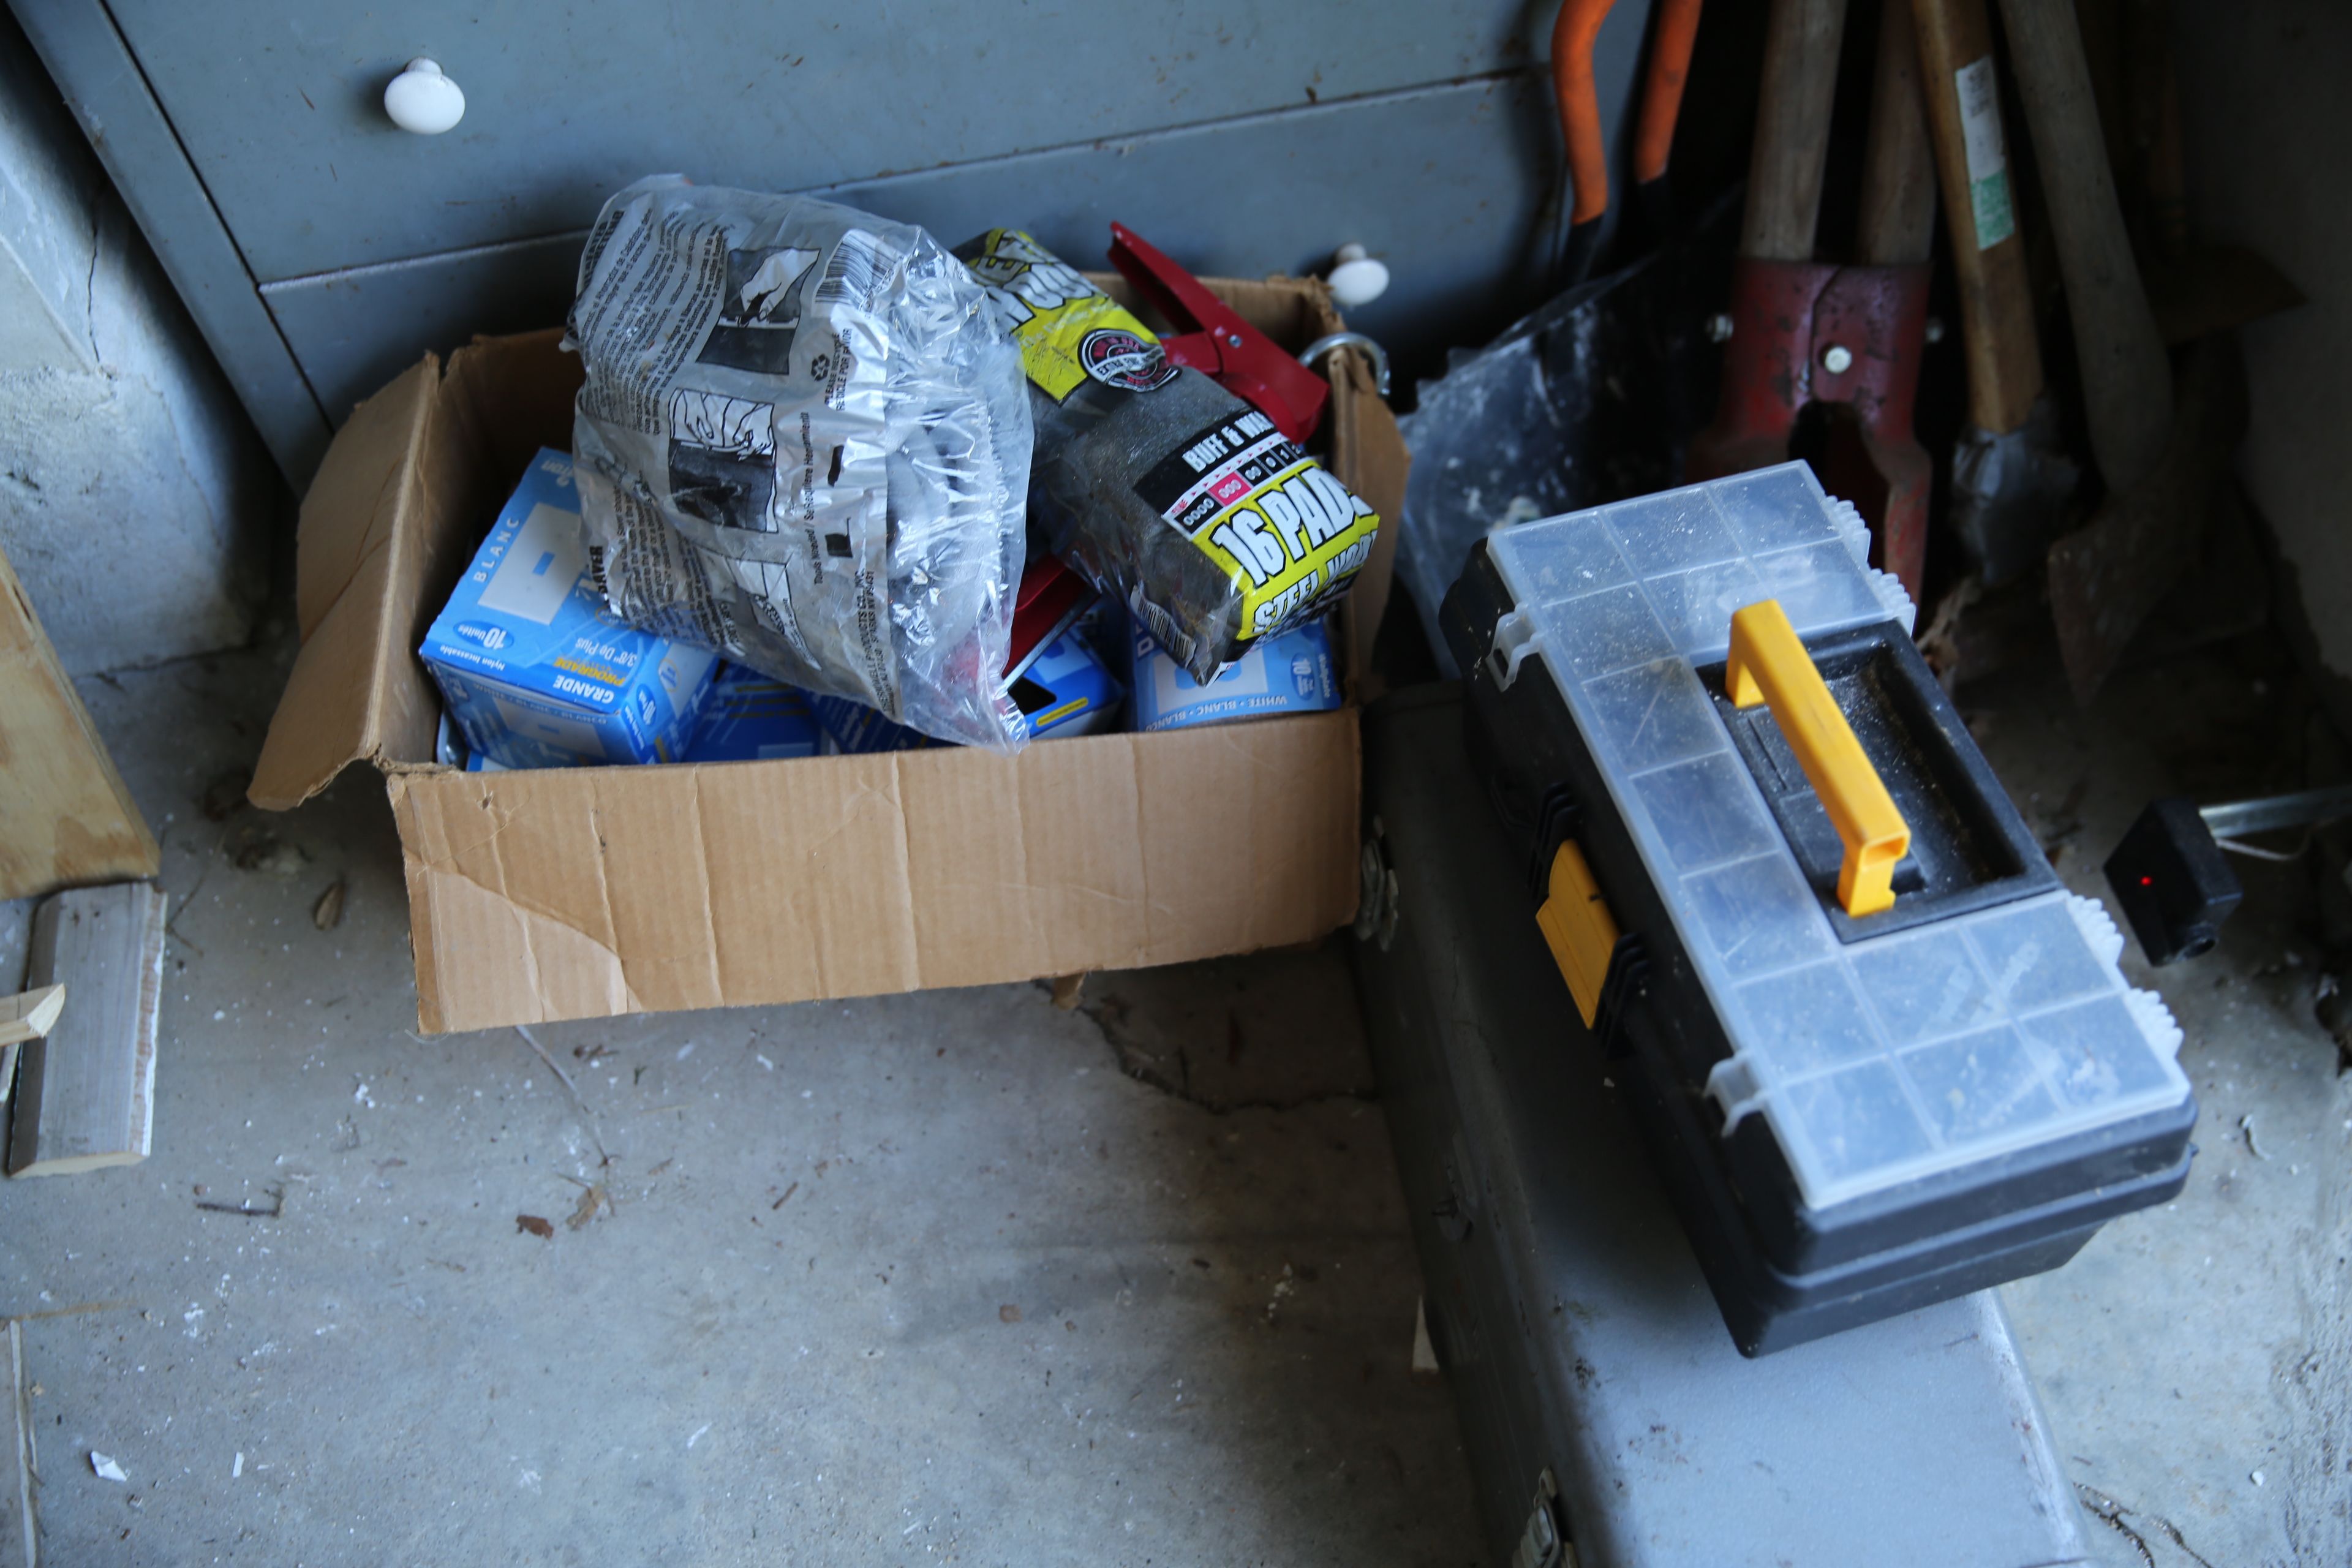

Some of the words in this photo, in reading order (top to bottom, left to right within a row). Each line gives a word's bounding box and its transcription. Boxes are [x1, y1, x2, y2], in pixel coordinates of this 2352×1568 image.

[839, 356, 850, 375] POR
[823, 372, 837, 405] PLEASE
[1180, 431, 1230, 475] BUFF
[1220, 422, 1245, 450] &
[473, 516, 521, 584] BLANC
[804, 529, 820, 560] Needed
[1209, 508, 1286, 589] 16
[813, 560, 823, 585] Tools
[481, 625, 507, 651] 10
[856, 609, 875, 662] PRODUCTS
[866, 610, 880, 644] SPARKS
[439, 644, 481, 664] Incassable
[574, 636, 599, 656] Plus
[481, 655, 506, 672] Nylon
[552, 655, 626, 687] PROGRADE
[1291, 653, 1316, 675] 10
[552, 673, 616, 704] GRANDE
[1246, 695, 1287, 707] WHITE
[1195, 699, 1236, 715] BLANC
